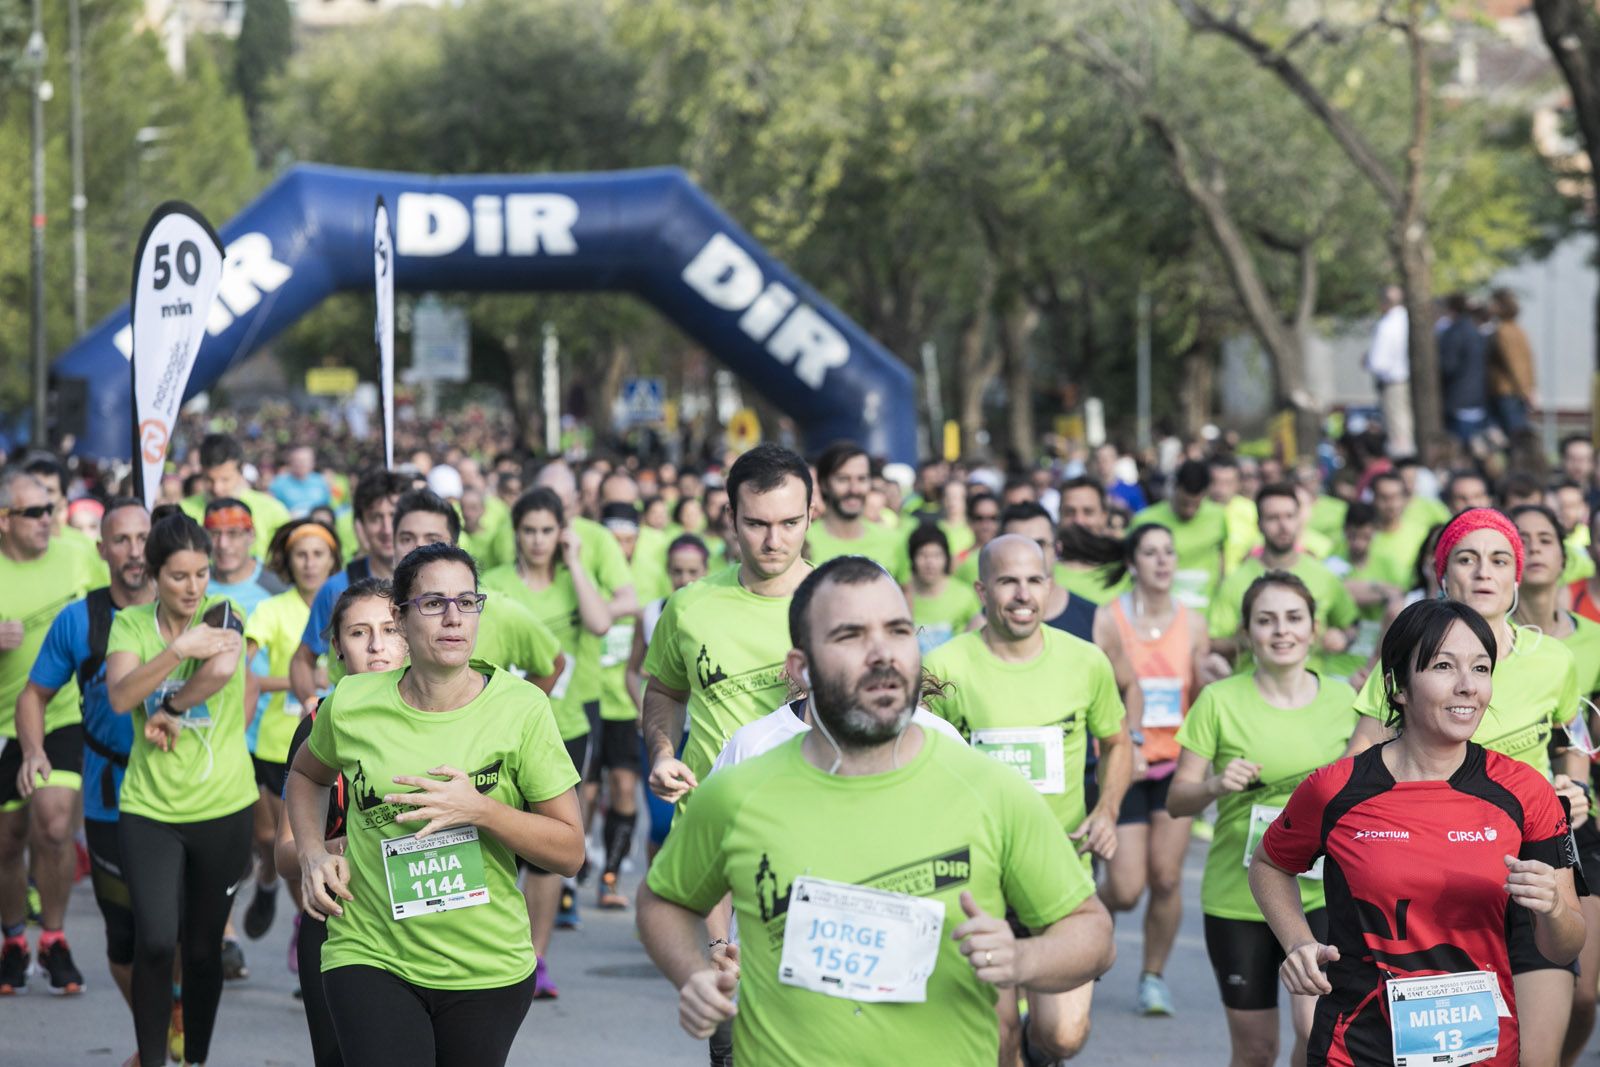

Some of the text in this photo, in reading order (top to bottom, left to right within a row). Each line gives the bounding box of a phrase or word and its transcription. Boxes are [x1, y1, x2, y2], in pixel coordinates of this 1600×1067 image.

[396, 192, 580, 256] DiR
[153, 239, 200, 290] 50
[161, 297, 192, 318] min
[681, 233, 850, 389] DiR
[476, 771, 498, 787] DiR
[1447, 830, 1485, 842] CIRSA
[408, 854, 463, 877] MAIA
[935, 860, 969, 878] DiR
[411, 873, 467, 898] 1144
[808, 917, 887, 949] JORGE
[811, 945, 880, 977] 1567
[1409, 1005, 1482, 1028] MIREIA
[1433, 1028, 1463, 1052] 13
